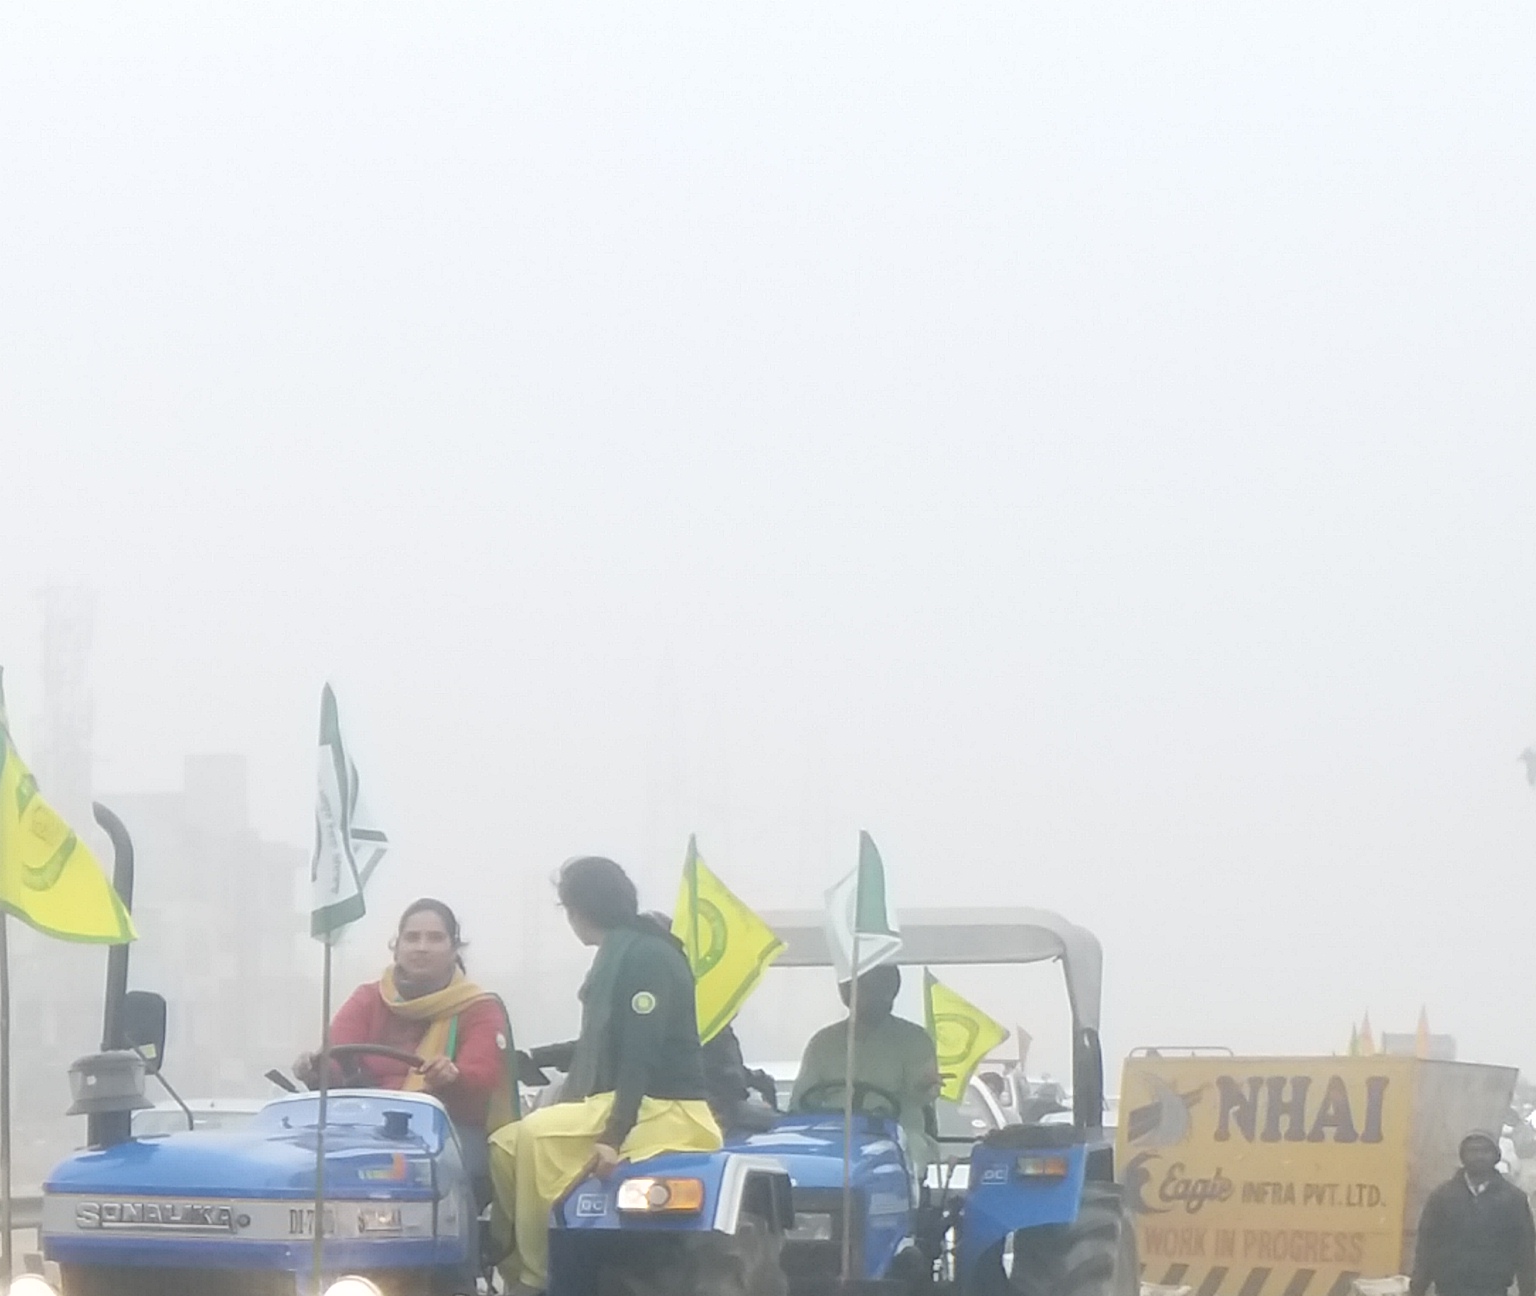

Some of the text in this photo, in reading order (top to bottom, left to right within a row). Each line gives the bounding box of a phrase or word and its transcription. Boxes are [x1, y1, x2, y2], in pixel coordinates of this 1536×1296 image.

[1214, 1075, 1389, 1143] NHAI
[1159, 1162, 1235, 1214] Eagle
[1242, 1181, 1295, 1205] INFRA
[1145, 1227, 1365, 1264] WORK IN PROGRESS
